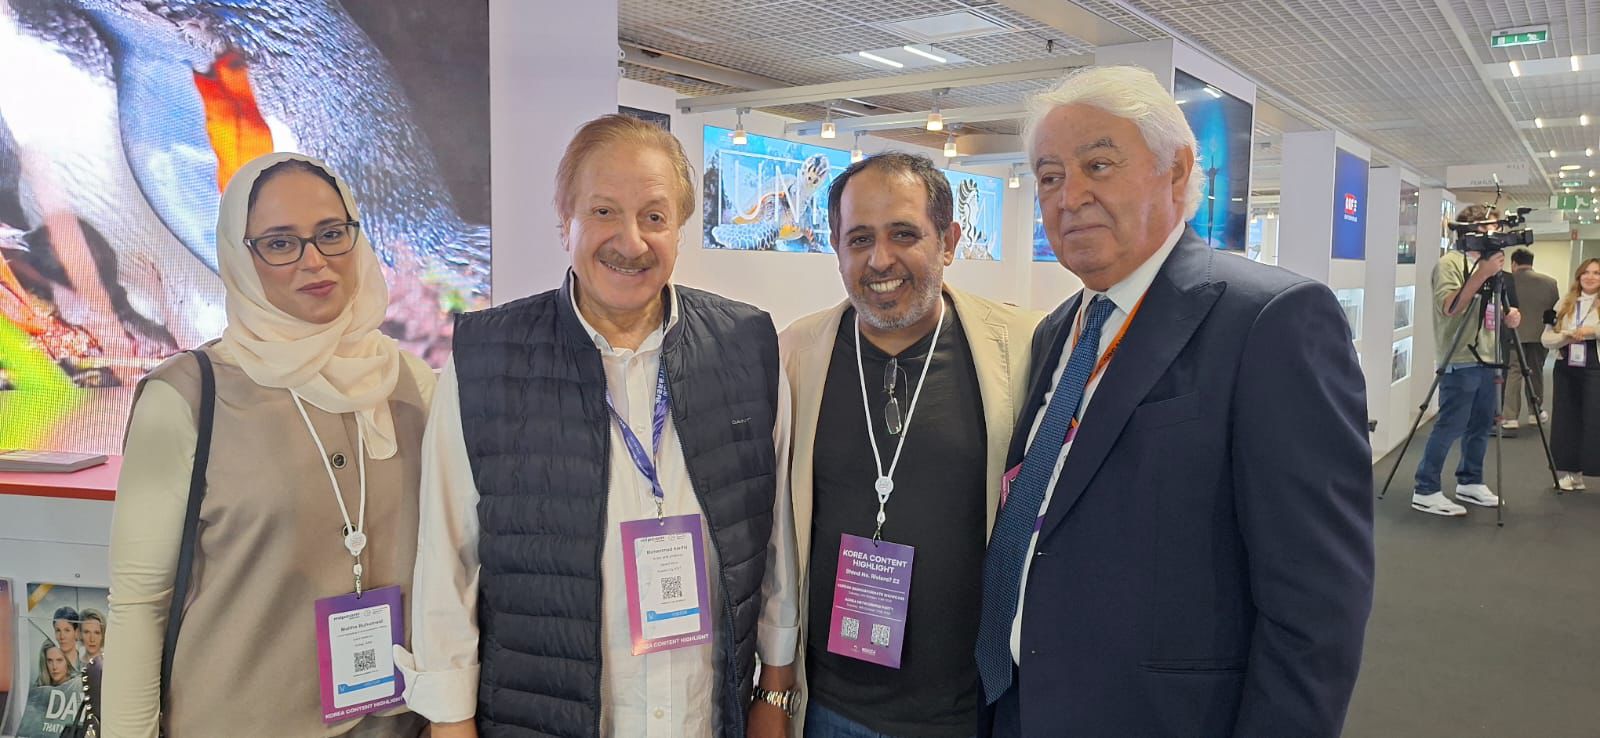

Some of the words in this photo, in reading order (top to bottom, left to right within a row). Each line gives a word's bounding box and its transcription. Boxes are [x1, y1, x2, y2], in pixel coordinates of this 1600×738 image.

[843, 549, 868, 560] KOREA
[869, 554, 908, 568] CONTENT
[852, 559, 895, 574] HIGHLIGHT
[653, 638, 680, 648] CONTENT
[680, 633, 709, 643] HIGHLIGHT
[325, 710, 345, 720] KOREA
[345, 703, 373, 715] CONTENT
[373, 695, 404, 708] HIGHLIGHT
